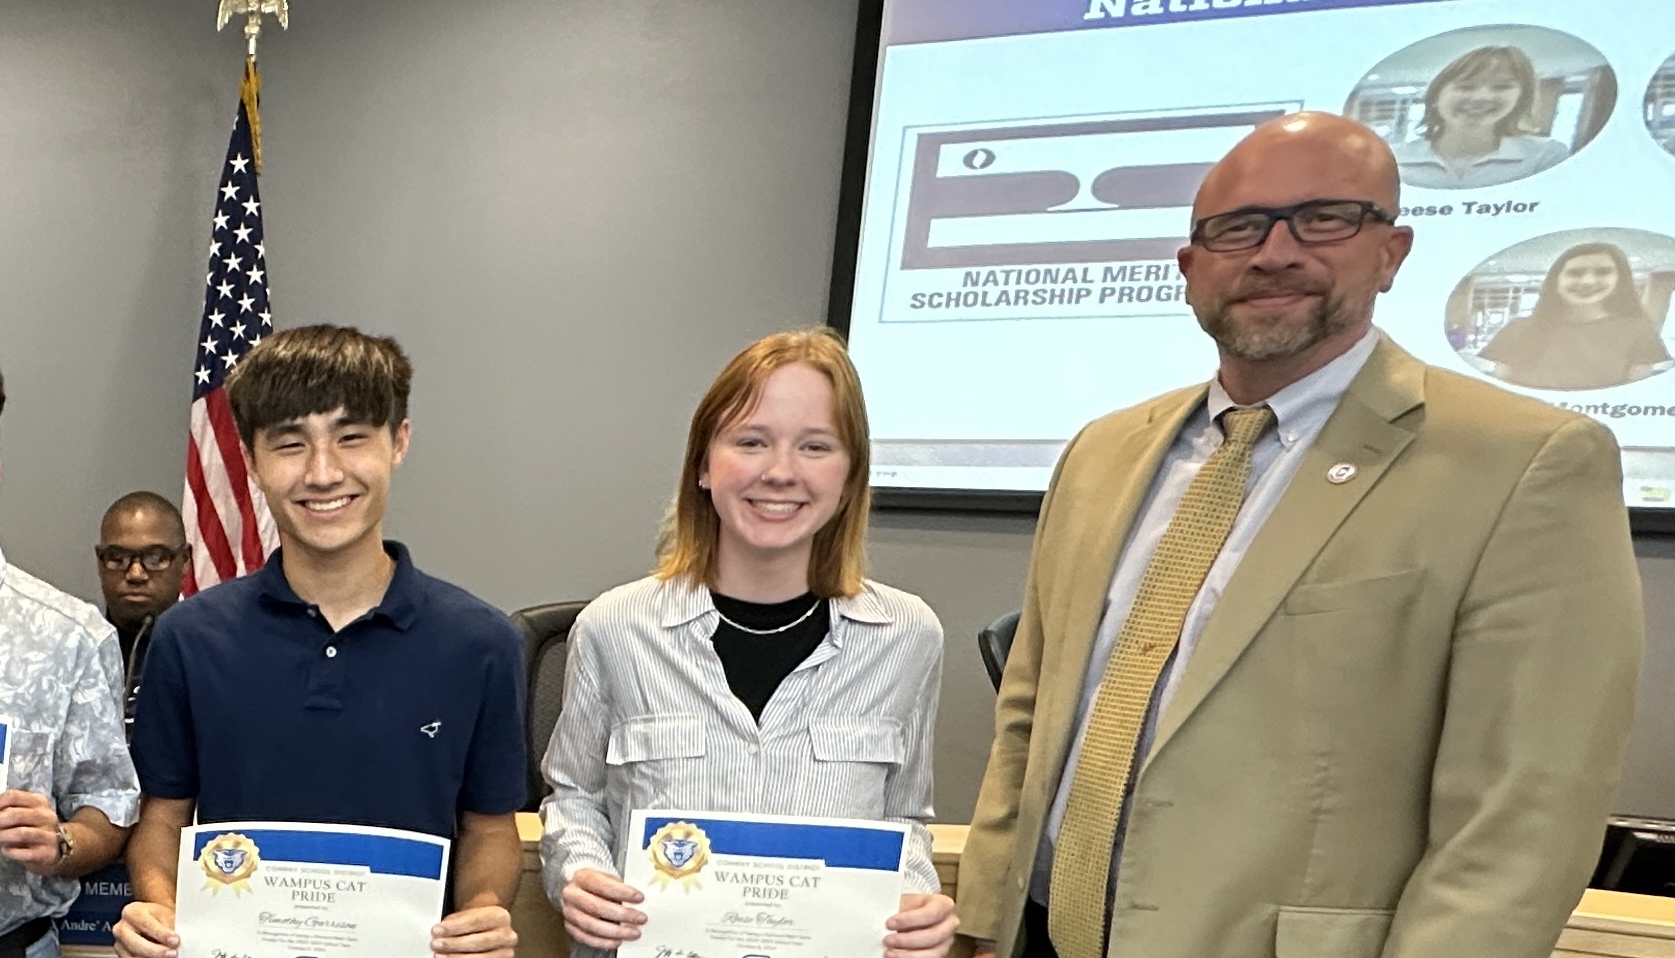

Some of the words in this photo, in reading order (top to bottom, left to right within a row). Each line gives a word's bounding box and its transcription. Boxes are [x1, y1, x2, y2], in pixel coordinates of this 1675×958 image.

[1397, 203, 1453, 217] eese
[1461, 200, 1541, 217] Taylor
[961, 266, 1095, 288] NATIONAL
[909, 286, 1091, 309] SCHOLARSHIP
[1551, 400, 1675, 419] ontgome
[264, 876, 331, 890] WAMPUS
[336, 880, 366, 892] CAT
[714, 871, 784, 886] WAMPUS
[789, 875, 821, 888] CAT
[85, 881, 134, 897] MEMB
[291, 890, 336, 903] PRIDE
[743, 886, 789, 900] PRIDE
